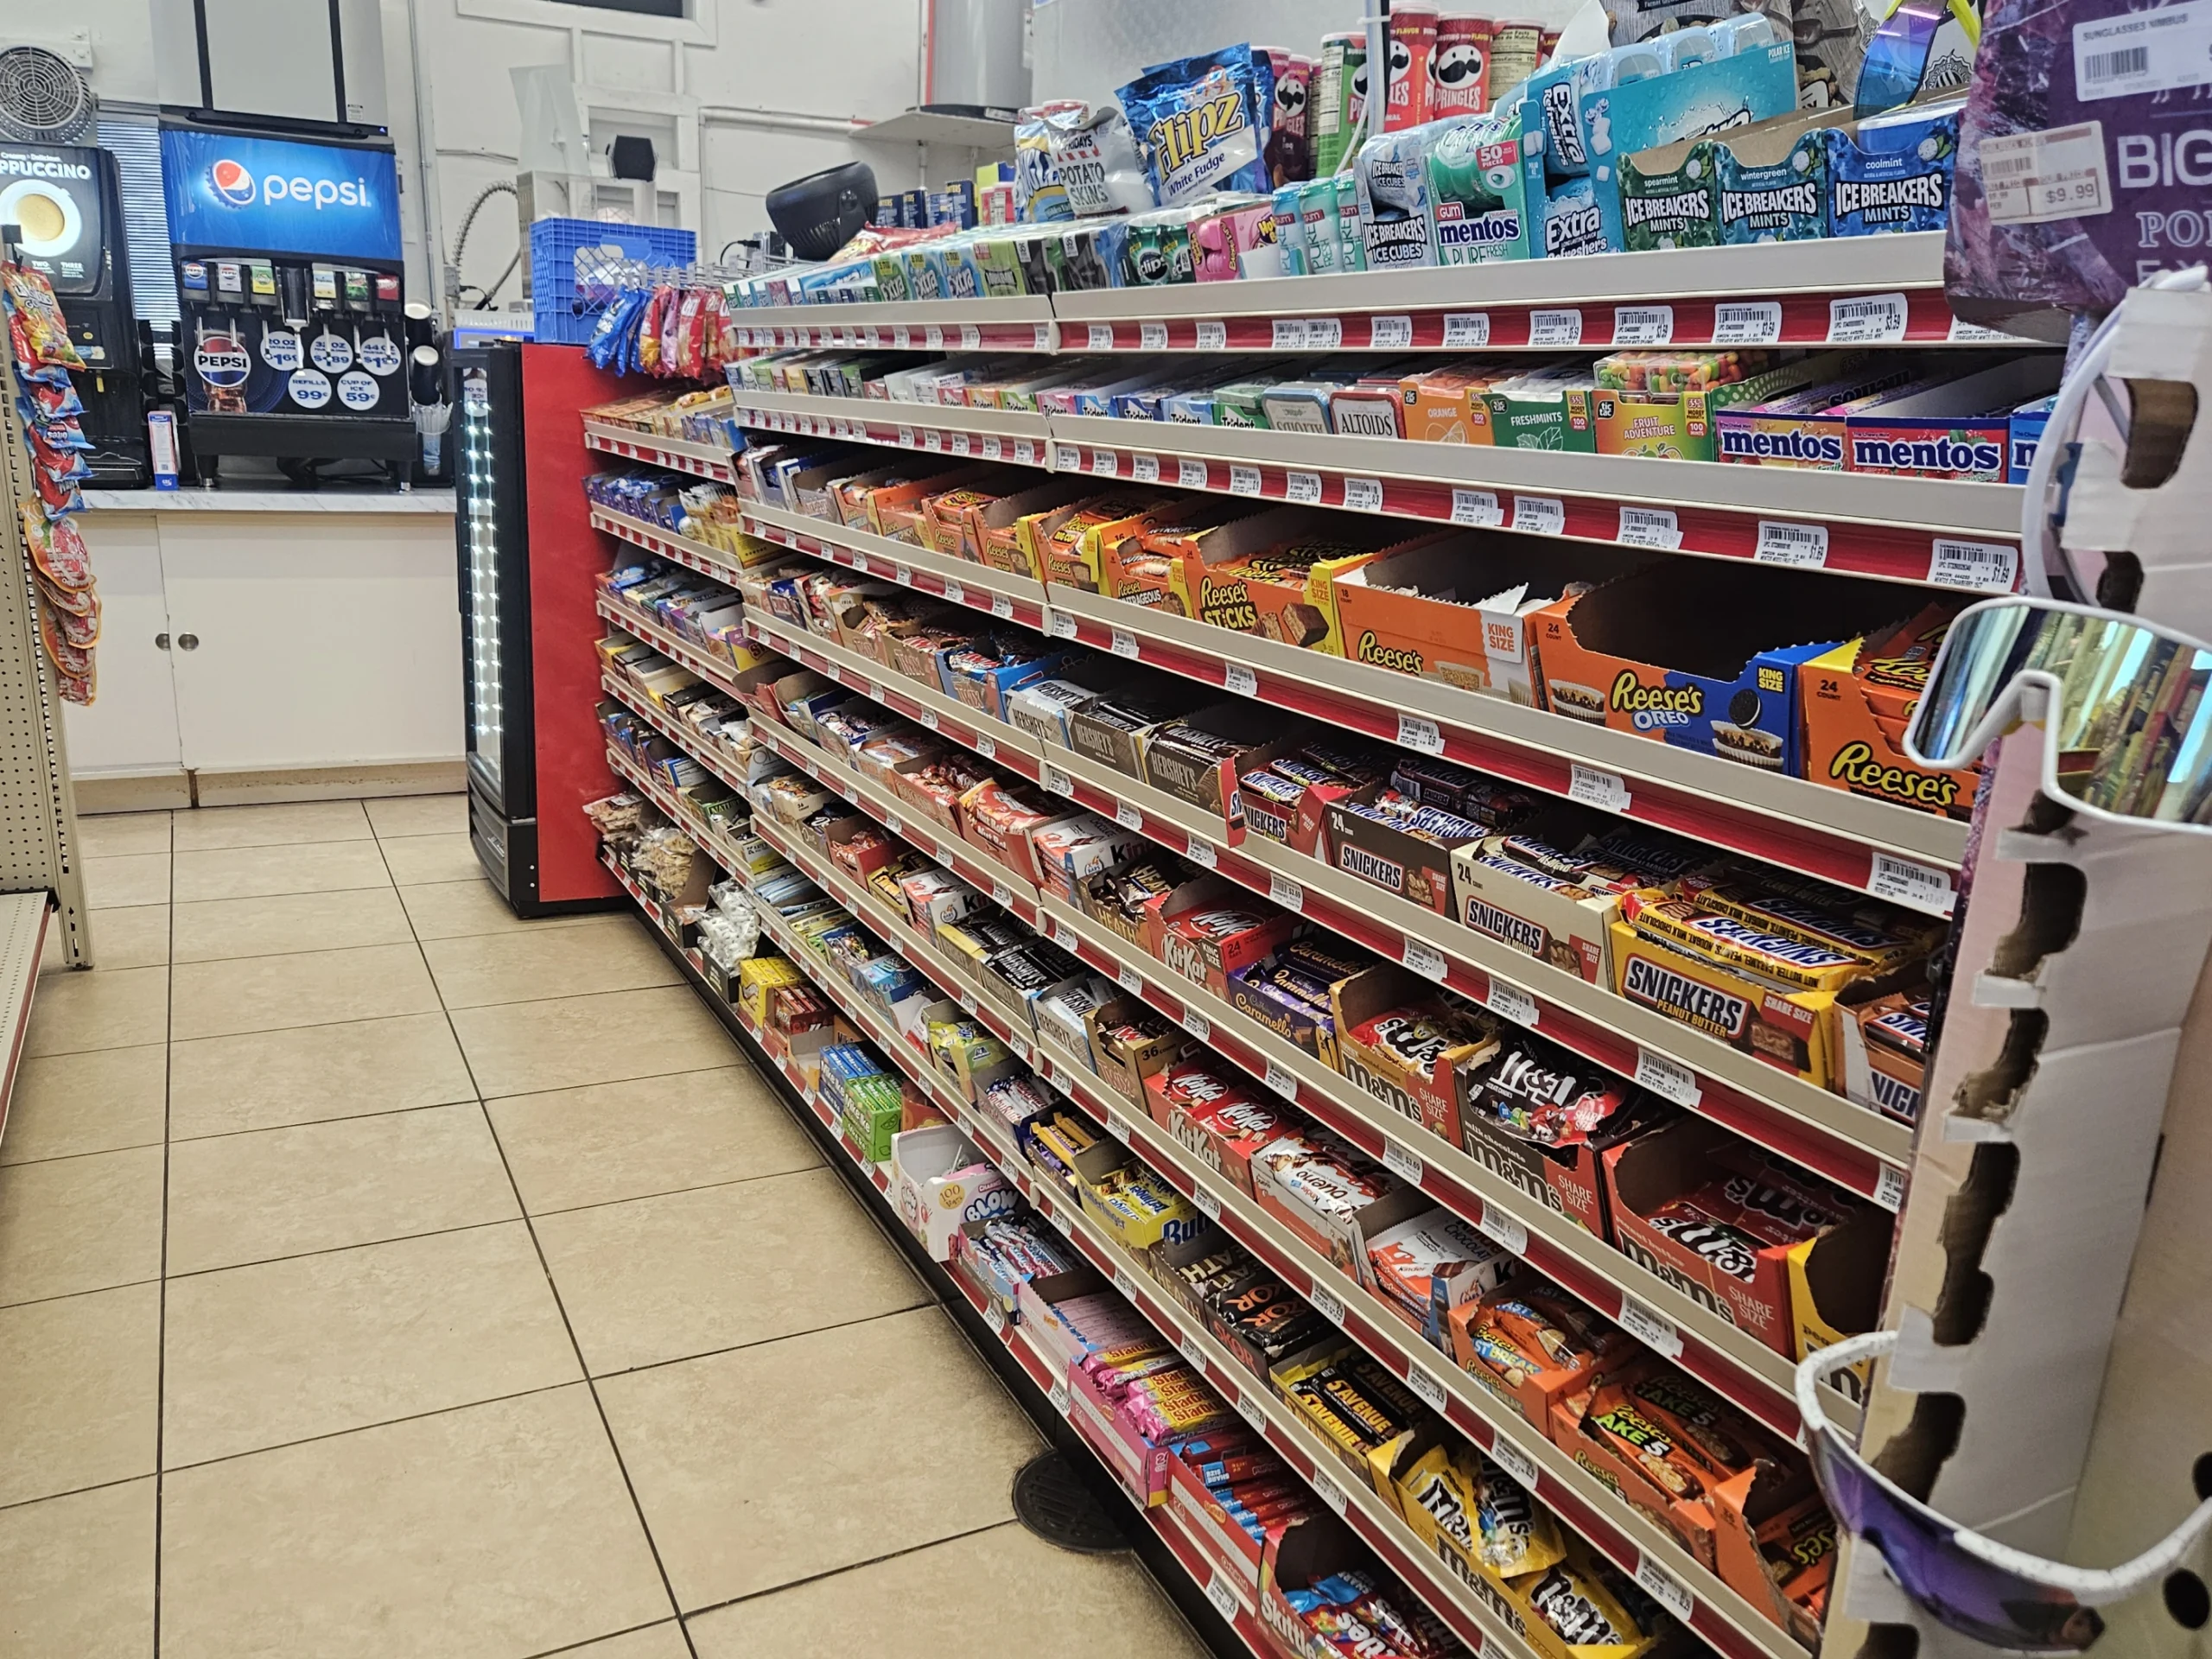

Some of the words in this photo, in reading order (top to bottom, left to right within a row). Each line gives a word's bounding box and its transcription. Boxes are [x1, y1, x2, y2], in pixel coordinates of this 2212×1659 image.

[2082, 22, 2146, 41] SUNGLASSES
[1768, 48, 1782, 60] POLAR
[1434, 85, 1481, 111] PRINGLES
[1552, 83, 1585, 164] Extra
[1480, 145, 1503, 162] 50
[1482, 159, 1503, 168] PIECES
[1866, 157, 1903, 169] coolmint
[2118, 129, 2212, 188] BIG
[1058, 162, 1105, 186] POTATO
[1167, 171, 1193, 198] White
[1194, 151, 1225, 181] Fudge
[1387, 177, 1406, 188] CUBES
[1644, 175, 1679, 188] spearmint
[1740, 168, 1788, 182] wintergreen
[263, 175, 368, 210] pepsi
[1070, 184, 1109, 207] SKINS
[1836, 182, 1864, 217] ICE
[1864, 174, 1943, 207] BREAKERS
[2046, 183, 2094, 204] $9.99
[1626, 197, 1643, 227] ICE
[1643, 189, 1710, 219] BREAKERS
[1722, 193, 1738, 224] ICE
[1738, 183, 1816, 218] BREAKERS
[1649, 218, 1685, 232] MINTS
[1750, 213, 1789, 228] MINTS
[1865, 207, 1910, 223] MINTS
[1364, 223, 1380, 251] ICE
[1380, 216, 1427, 247] BREAKERS
[1439, 216, 1521, 245] mentos
[1546, 207, 1601, 251] Extra
[1306, 224, 1325, 270] PURE
[1340, 218, 1356, 265] PURE
[1486, 245, 1508, 258] FRESH
[1373, 246, 1389, 263] ICE
[1389, 243, 1424, 262] CUBES
[946, 268, 974, 298] Extra
[198, 354, 247, 368] PEPSI
[1125, 409, 1154, 421] Trident
[1427, 407, 1458, 419] ORANGE
[1599, 409, 1612, 417] tac
[1600, 401, 1612, 410] tic
[1170, 412, 1202, 425] Trident
[1221, 416, 1255, 429] Trident
[1341, 412, 1393, 437] ALTOIDS
[1510, 410, 1563, 427] FRESHMINTS
[1573, 417, 1586, 426] 100
[1633, 416, 1659, 429] FRUIT
[1690, 423, 1704, 431] 100
[1623, 424, 1675, 440] ADVENTURE
[1722, 429, 1842, 461] mentos
[1855, 437, 2000, 471] mentos
[986, 538, 1009, 559] Reese's
[1048, 554, 1071, 575] Reese's
[1117, 579, 1141, 596] Reese's
[1200, 575, 1249, 607] Reese's
[1310, 577, 1328, 591] KING
[1311, 588, 1330, 601] SIZE
[1341, 588, 1350, 598] 18
[1487, 622, 1515, 641] KING
[1545, 632, 1562, 641] COUNT
[1548, 622, 1560, 636] 24
[1357, 630, 1424, 674] Reese's
[1488, 636, 1516, 652] SIZE
[1758, 666, 1783, 682] KING
[1611, 670, 1703, 716] Reese's
[1758, 678, 1783, 692] SIZE
[1820, 678, 1839, 693] 24
[1816, 690, 1841, 702] COUNT
[1012, 708, 1049, 740] HERSHEY'S
[1632, 709, 1690, 731] OREO
[1074, 721, 1115, 757] HERSHEY'S
[1150, 751, 1197, 791] HERSHEY'S
[1828, 740, 1961, 808] Reese's
[1331, 811, 1344, 832] 24
[1343, 845, 1402, 891] SNICKERS
[1432, 871, 1446, 883] SHARE
[1457, 862, 1472, 885] 24
[1436, 880, 1446, 893] SIZE
[1098, 908, 1137, 944] HEATH
[1468, 899, 1543, 952] SNICKERS
[1202, 943, 1219, 958] KING
[1227, 941, 1241, 952] 24
[1503, 936, 1535, 955] ALMOND
[1582, 942, 1600, 955] SHARE
[1206, 955, 1221, 969] SIZE
[1585, 952, 1599, 965] SIZE
[1627, 963, 1744, 1032] SNICKERS
[1235, 992, 1293, 1039] Caramello
[1656, 999, 1692, 1022] PEANUT
[1691, 1012, 1727, 1037] BUTTER
[1764, 995, 1790, 1018] SHARE
[1792, 1008, 1815, 1025] SIZE
[1141, 1046, 1159, 1061] 36
[1341, 1052, 1424, 1125] m&m's
[1420, 1087, 1448, 1113] SHARE
[1426, 1102, 1446, 1122] SIZE
[1485, 1134, 1526, 1164] chocolate
[1466, 1131, 1564, 1213] m&m's
[939, 1184, 961, 1203] 100
[1558, 1174, 1594, 1205] SHARE
[964, 1187, 1020, 1222] BLOW
[1566, 1192, 1589, 1215] SIZE
[1729, 1286, 1775, 1320] SHARE
[1739, 1306, 1768, 1331] SIZE
[1490, 1345, 1542, 1375] BREAK
[1340, 1386, 1392, 1436] AVENUE
[1317, 1402, 1362, 1452] AVENUE
